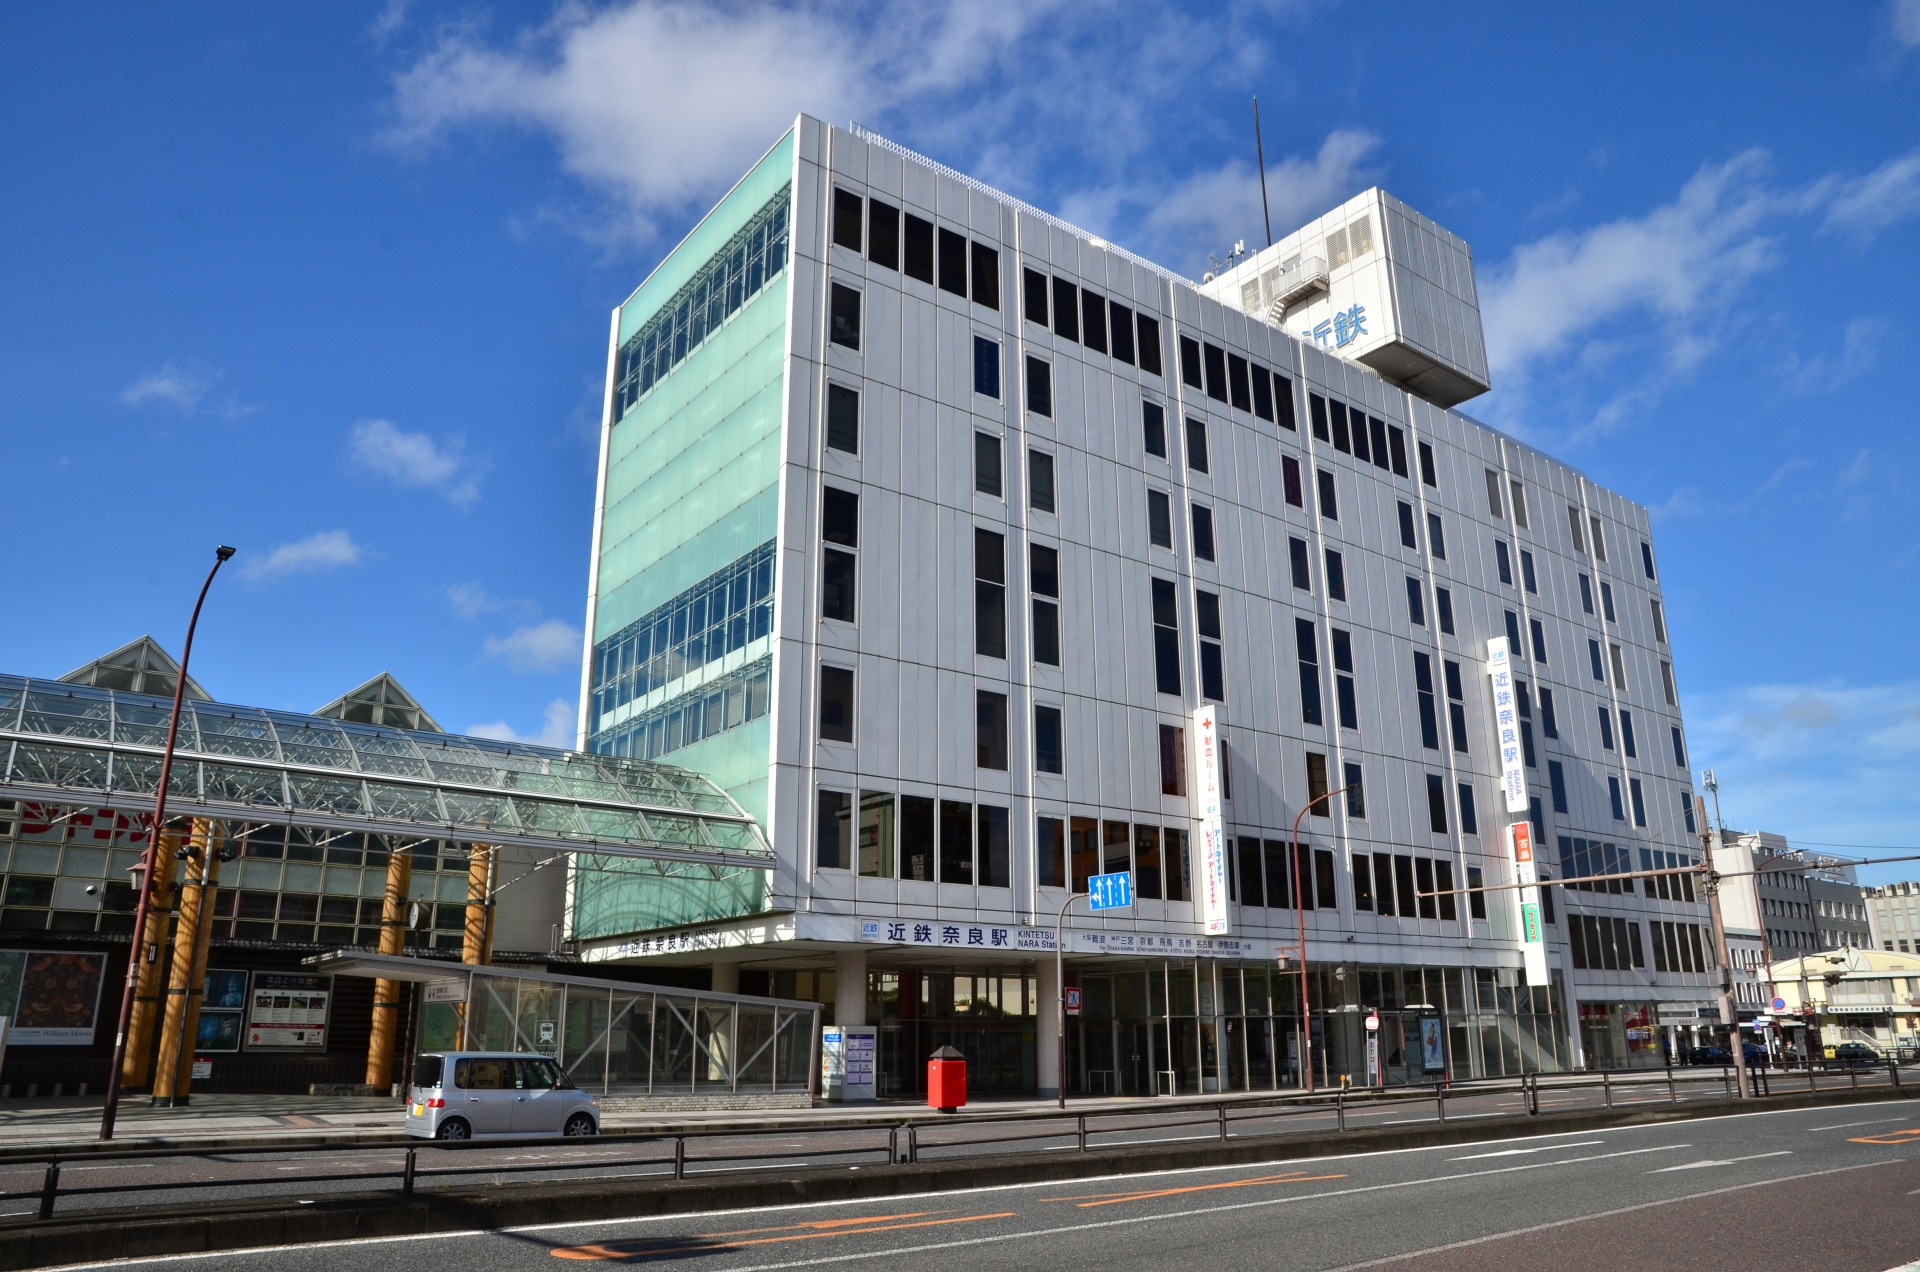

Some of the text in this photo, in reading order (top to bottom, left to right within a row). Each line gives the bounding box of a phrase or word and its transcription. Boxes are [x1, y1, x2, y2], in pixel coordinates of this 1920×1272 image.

[1302, 303, 1368, 351] 近鉄
[1495, 671, 1518, 763] 近鉄奈良駅
[1204, 736, 1215, 792] 献血ルーム
[1505, 770, 1515, 802] Station
[1513, 769, 1522, 796] NARA
[1206, 805, 1217, 814] 6F
[1214, 829, 1222, 883] アートネイチャー
[1206, 831, 1216, 909] レディース アートネイチャー
[695, 927, 718, 937] KINTETSU
[862, 922, 878, 933] 近鉄
[887, 922, 1008, 947] 近鉄奈良駅
[1017, 930, 1055, 939] KINTETSU
[1210, 923, 1218, 931] 4F
[630, 932, 690, 954] 近鉄奈良駅
[1018, 940, 1066, 949] NARA Statin
[1139, 937, 1153, 946] 京都
[1159, 938, 1173, 947] 飛鳥
[1178, 939, 1192, 947] 吉野
[1196, 939, 1213, 949] 名古屋
[1217, 940, 1240, 949] 伊勢志摩
